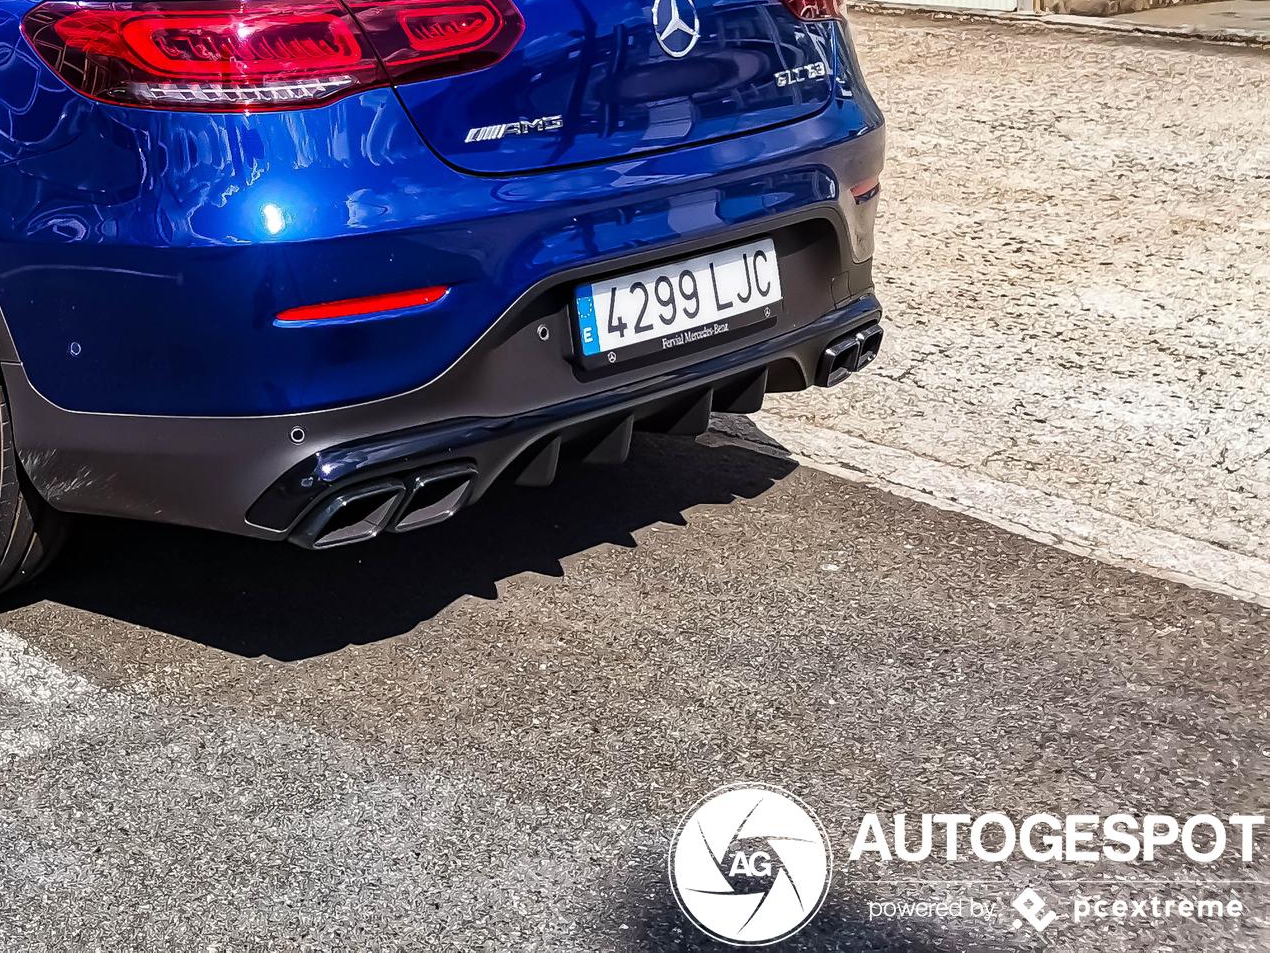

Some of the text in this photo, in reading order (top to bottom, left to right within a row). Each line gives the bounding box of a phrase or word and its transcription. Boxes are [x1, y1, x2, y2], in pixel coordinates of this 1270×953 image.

[501, 114, 564, 137] AMG
[607, 249, 771, 338] 4299 LJC
[582, 327, 594, 343] E
